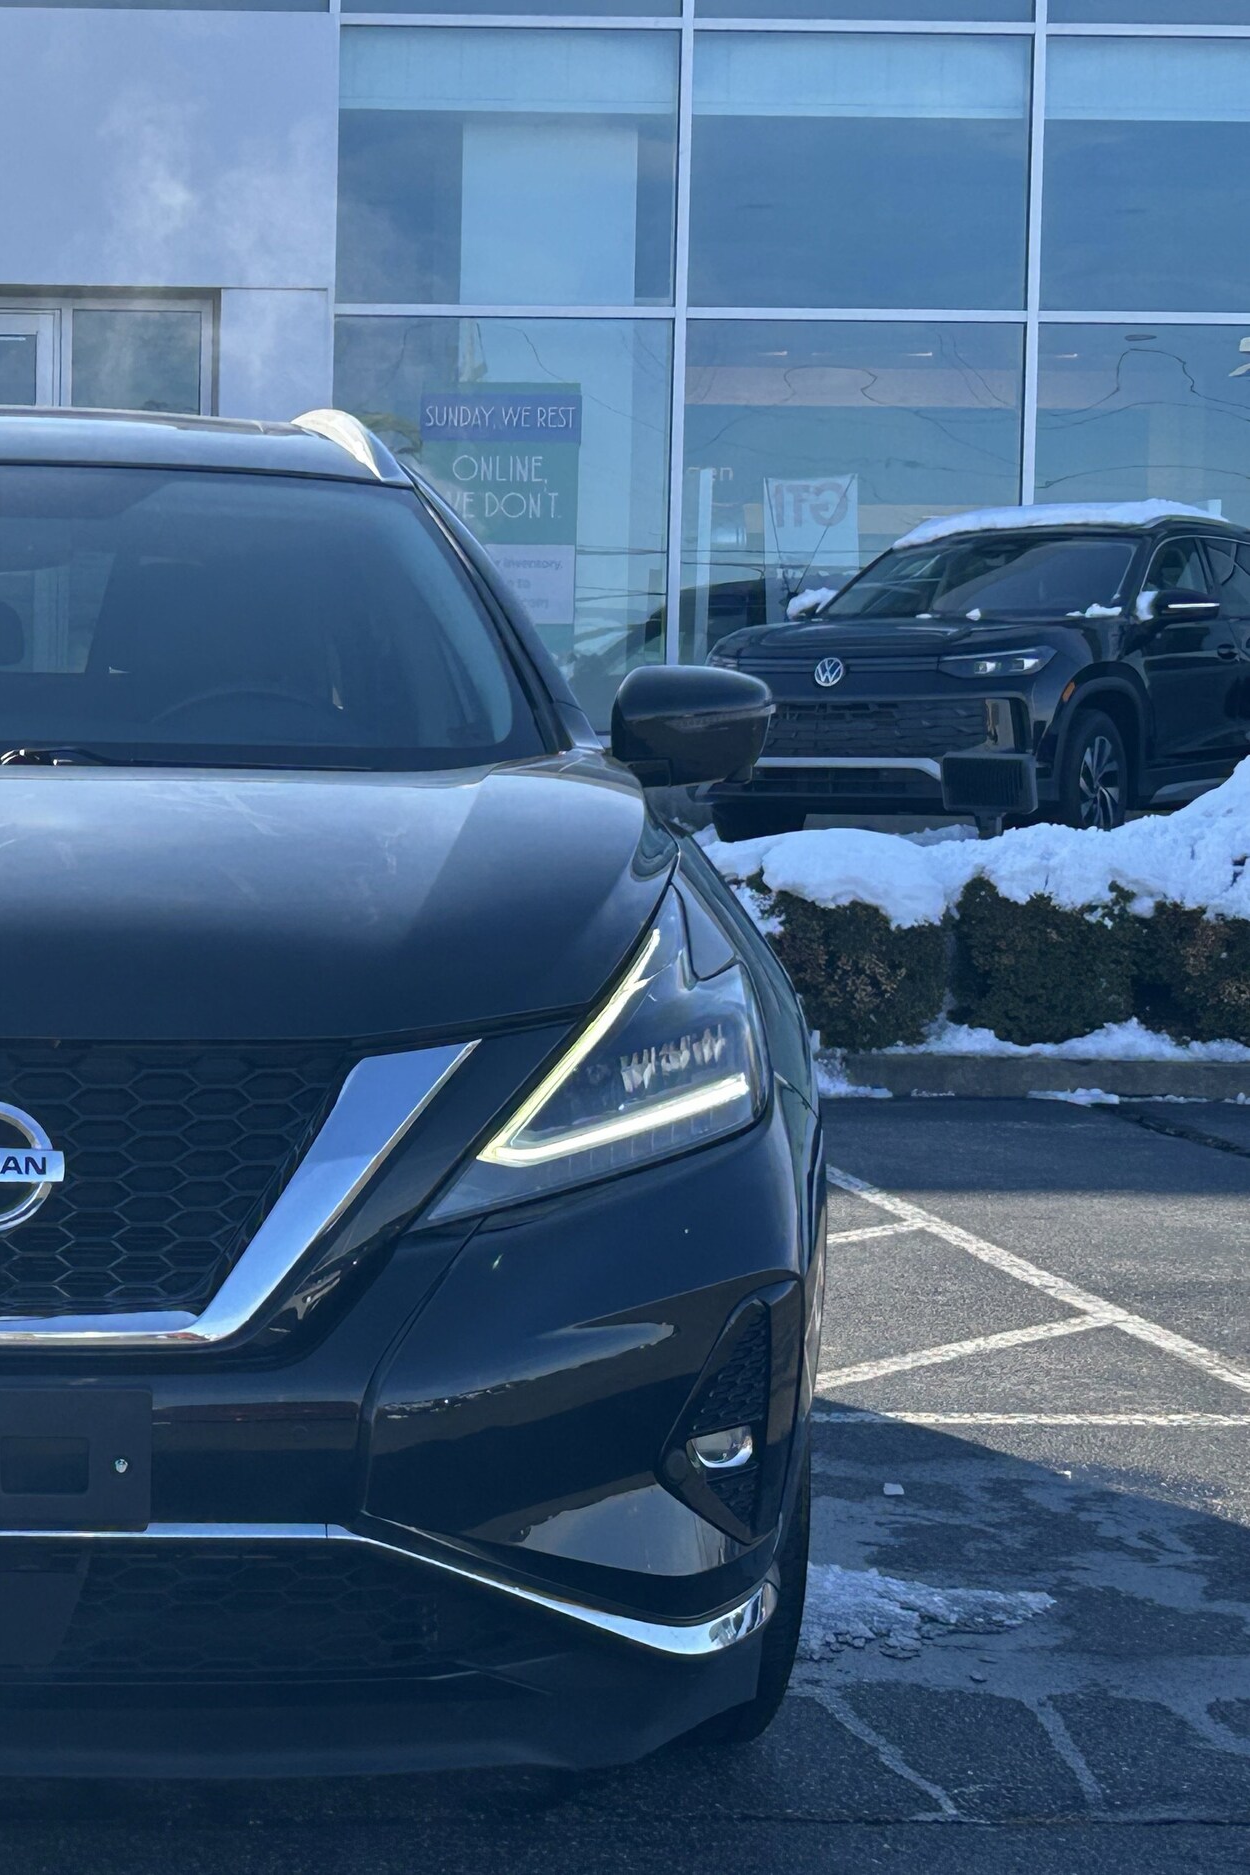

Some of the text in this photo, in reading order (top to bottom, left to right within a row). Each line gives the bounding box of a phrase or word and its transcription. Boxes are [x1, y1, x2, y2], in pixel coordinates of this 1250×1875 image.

[501, 406, 531, 428] WE
[537, 406, 577, 429] REST
[452, 454, 548, 484] ONLINE,
